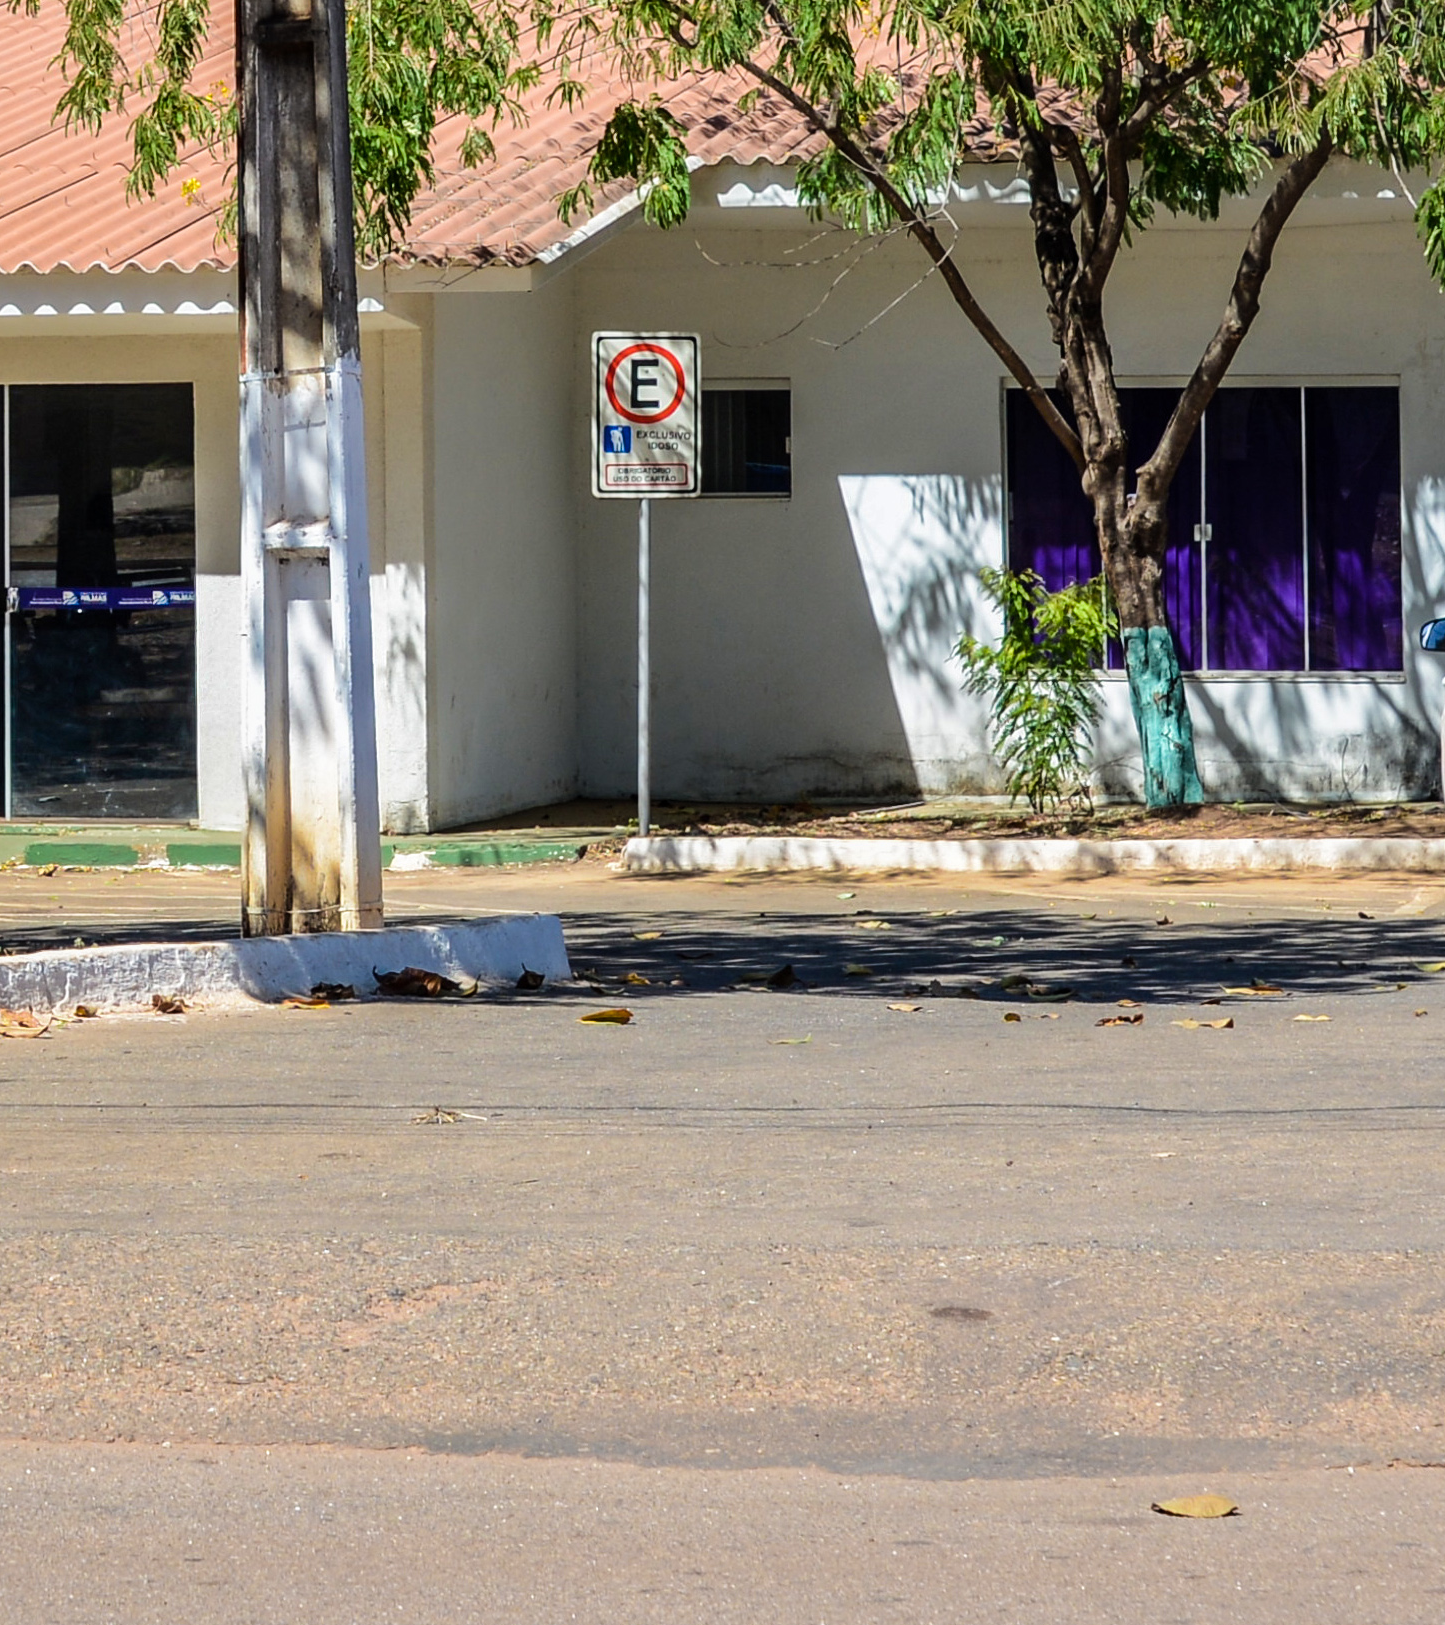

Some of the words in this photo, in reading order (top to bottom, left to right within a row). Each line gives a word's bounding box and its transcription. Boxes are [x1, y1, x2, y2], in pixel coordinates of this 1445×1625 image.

[630, 358, 660, 409] E
[636, 430, 691, 440] EXCLUSIVO
[648, 442, 679, 450] IDOSO
[645, 474, 676, 482] CARTÃO
